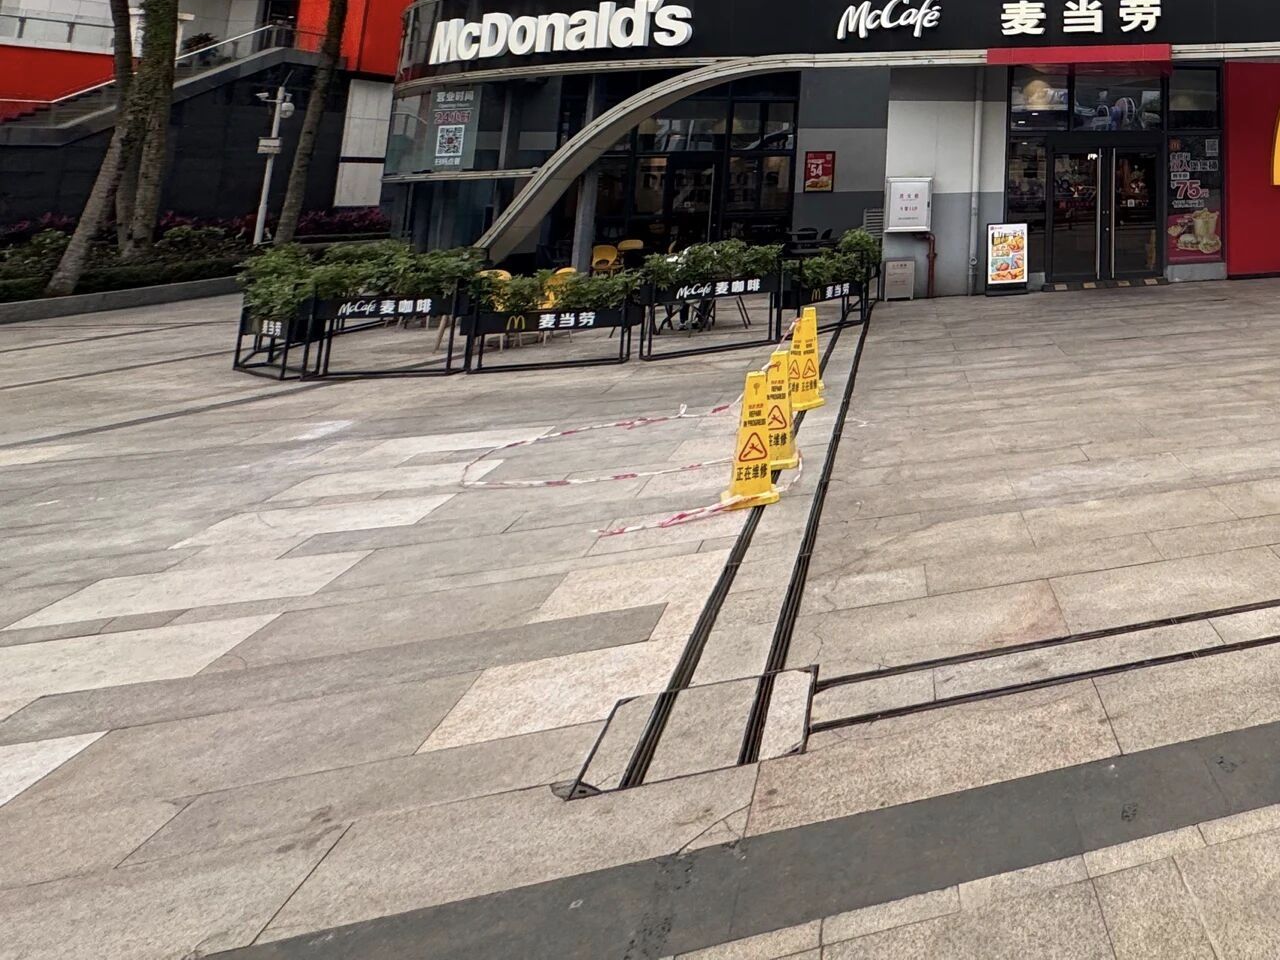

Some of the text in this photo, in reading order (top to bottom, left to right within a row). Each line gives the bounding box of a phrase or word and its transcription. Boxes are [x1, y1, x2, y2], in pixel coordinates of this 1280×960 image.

[429, 0, 693, 65] McDonald's
[715, 278, 761, 296] 麦咖啡
[825, 282, 850, 299] 麦当劳
[380, 298, 432, 315] 麦咖啡
[262, 319, 282, 336] 麦当劳
[538, 311, 596, 330] 麦当劳
[736, 463, 768, 481] 正在维修
